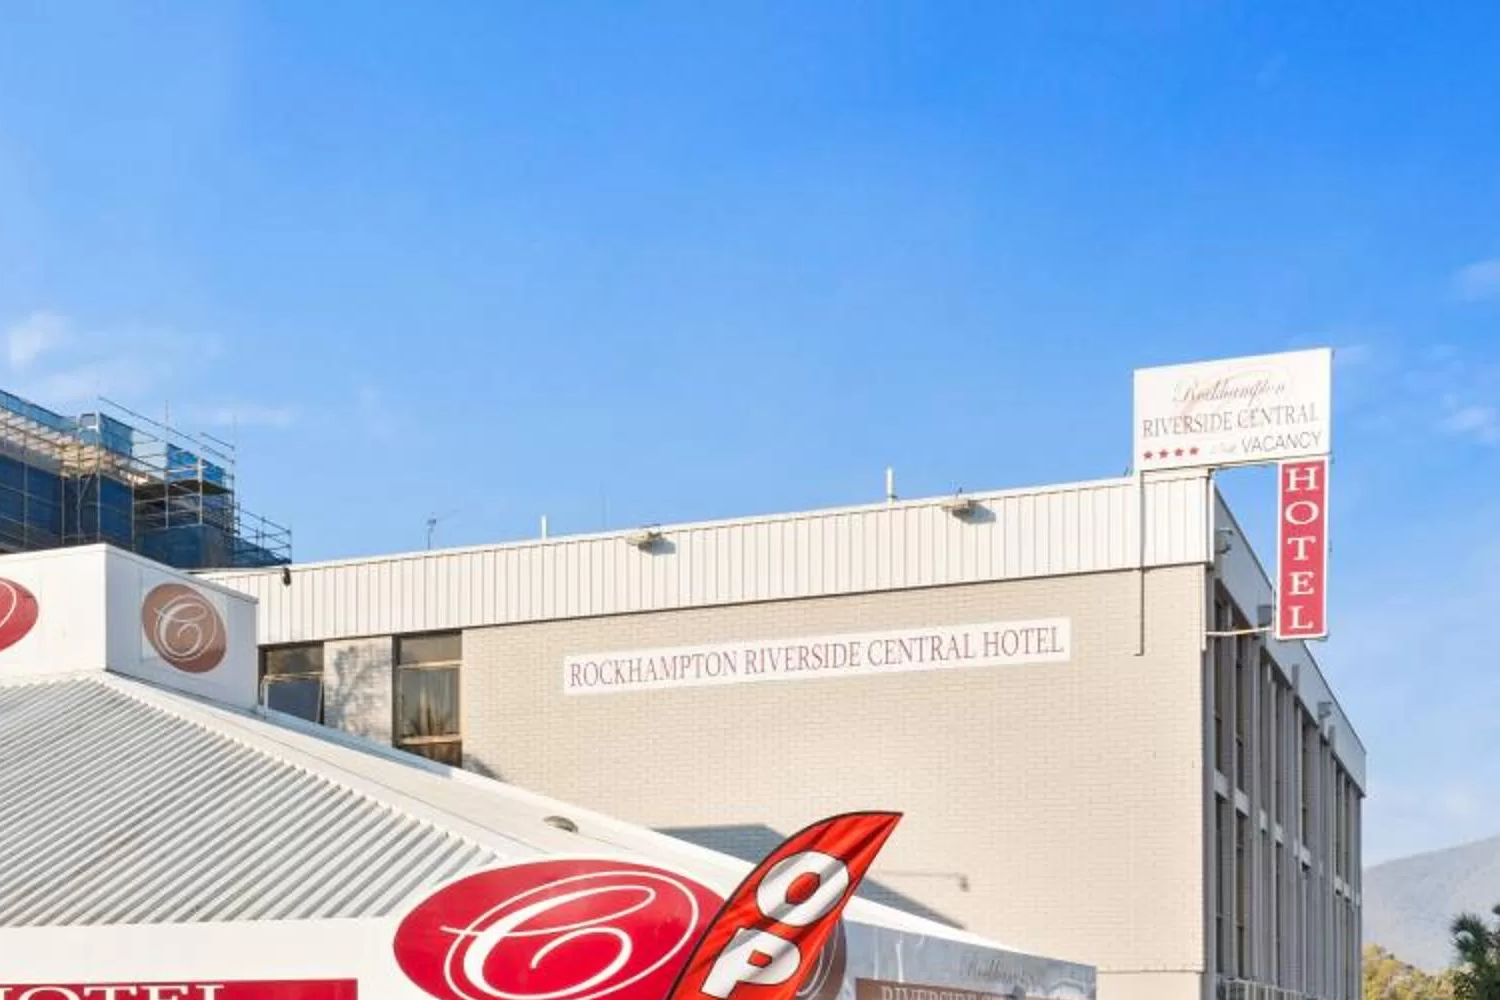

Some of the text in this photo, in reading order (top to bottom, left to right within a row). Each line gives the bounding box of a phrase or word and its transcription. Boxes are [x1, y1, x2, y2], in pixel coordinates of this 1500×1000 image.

[1143, 402, 1319, 439] RIVERSIDE CENTRAL
[1241, 430, 1322, 454] VACANCY
[1284, 466, 1320, 630] HOTEL
[568, 624, 1065, 688] ROCKHAMPTON RIVERSIDE CENTRAL HOTEL
